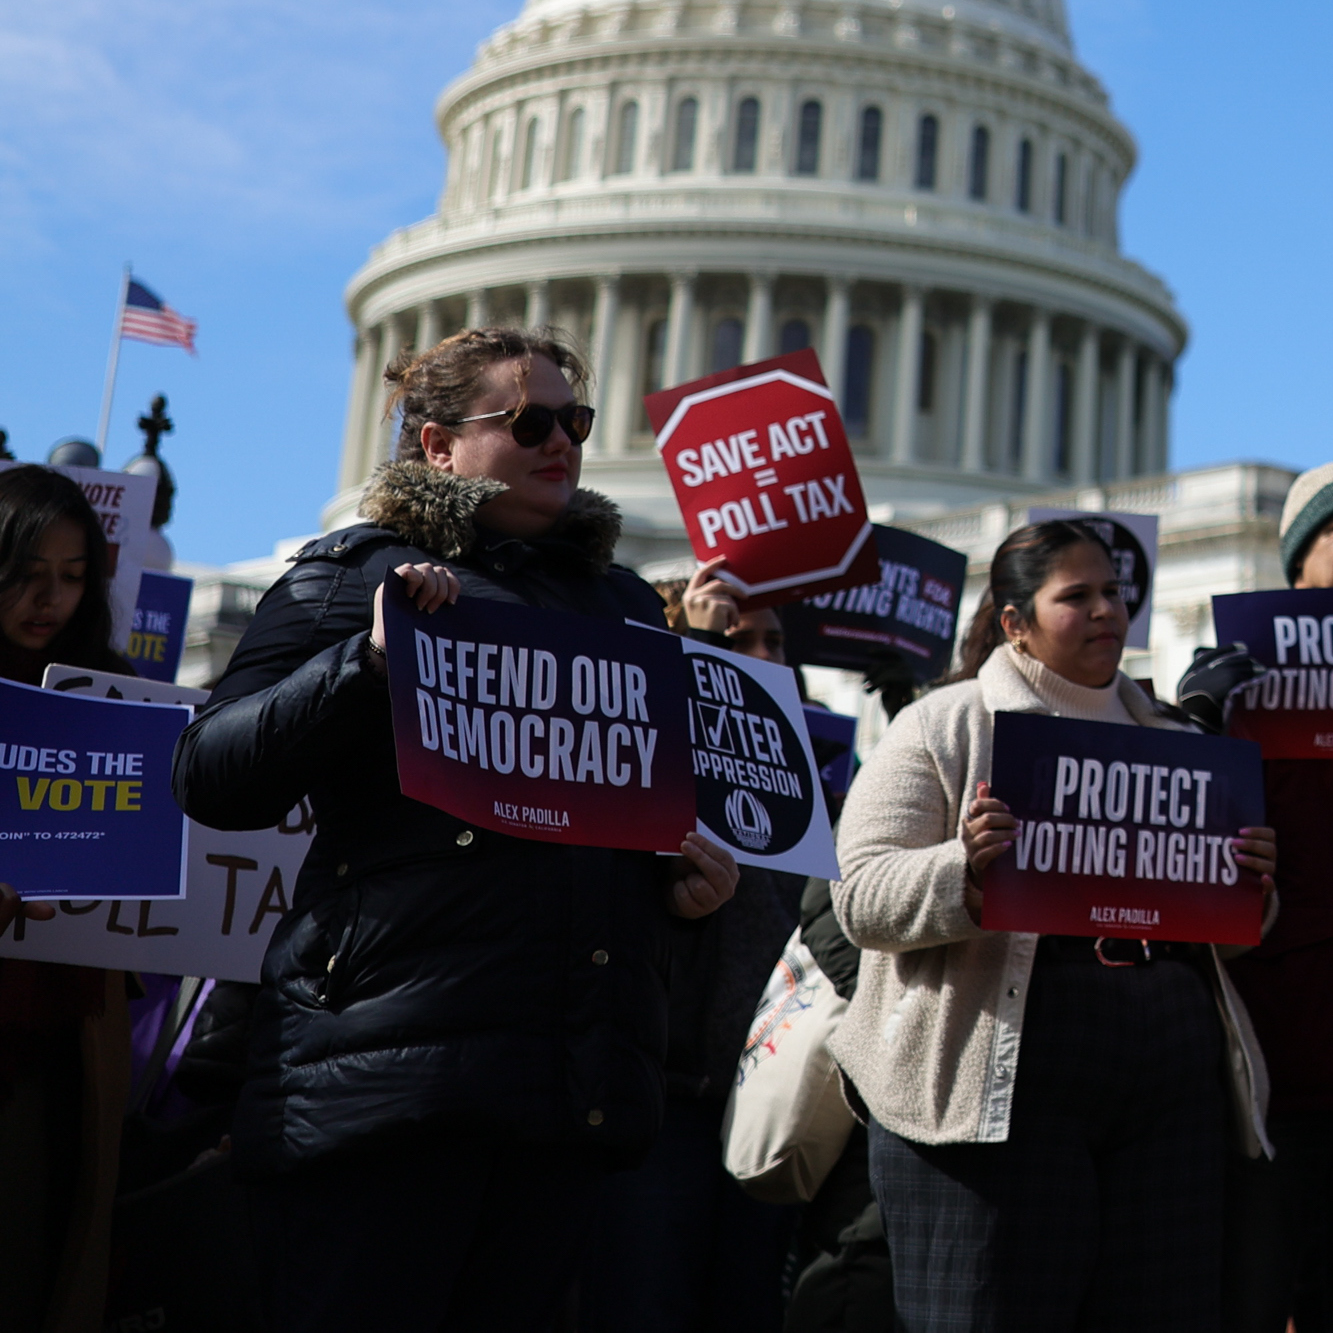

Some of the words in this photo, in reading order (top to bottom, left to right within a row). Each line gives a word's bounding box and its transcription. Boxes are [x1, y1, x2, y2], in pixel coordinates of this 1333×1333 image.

[676, 429, 767, 488] SAVE
[768, 410, 829, 462] ACT
[697, 491, 788, 549] POLL
[783, 473, 854, 524] TAX
[146, 609, 170, 633] THE
[896, 594, 954, 640] RIGHTS
[122, 633, 168, 661] OTE
[414, 628, 557, 710] DEFEND
[571, 655, 649, 722] OUR
[692, 658, 744, 708] END
[416, 687, 657, 788] DEMOCRACY
[86, 751, 143, 776] THE
[691, 749, 803, 800] PPRESSION
[16, 777, 142, 811] VOTE
[494, 800, 519, 821] ALEX
[522, 806, 570, 827] PADILLA
[1053, 755, 1212, 829] PROTECT
[34, 832, 51, 840] TO
[1016, 820, 1127, 878] VOTING
[1136, 829, 1238, 886] RIGHTS
[206, 854, 291, 936] TA
[1090, 906, 1116, 922] ALEX
[1118, 907, 1160, 925] PADILLA
